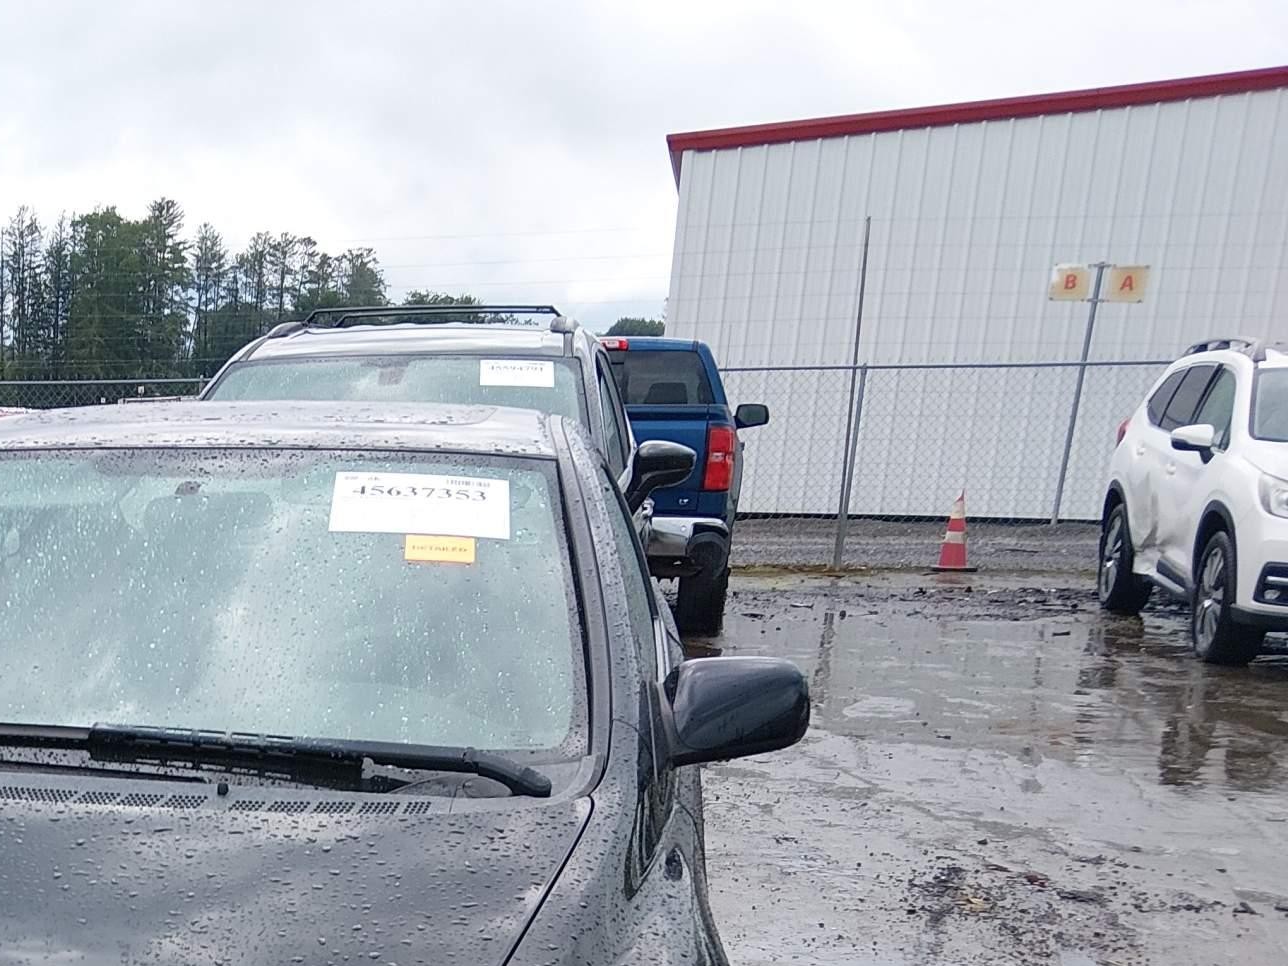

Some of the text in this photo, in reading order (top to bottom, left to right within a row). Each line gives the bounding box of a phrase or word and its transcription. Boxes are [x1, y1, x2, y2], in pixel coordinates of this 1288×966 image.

[1063, 273, 1078, 290] B
[1119, 275, 1135, 291] A
[352, 485, 488, 502] 45637353
